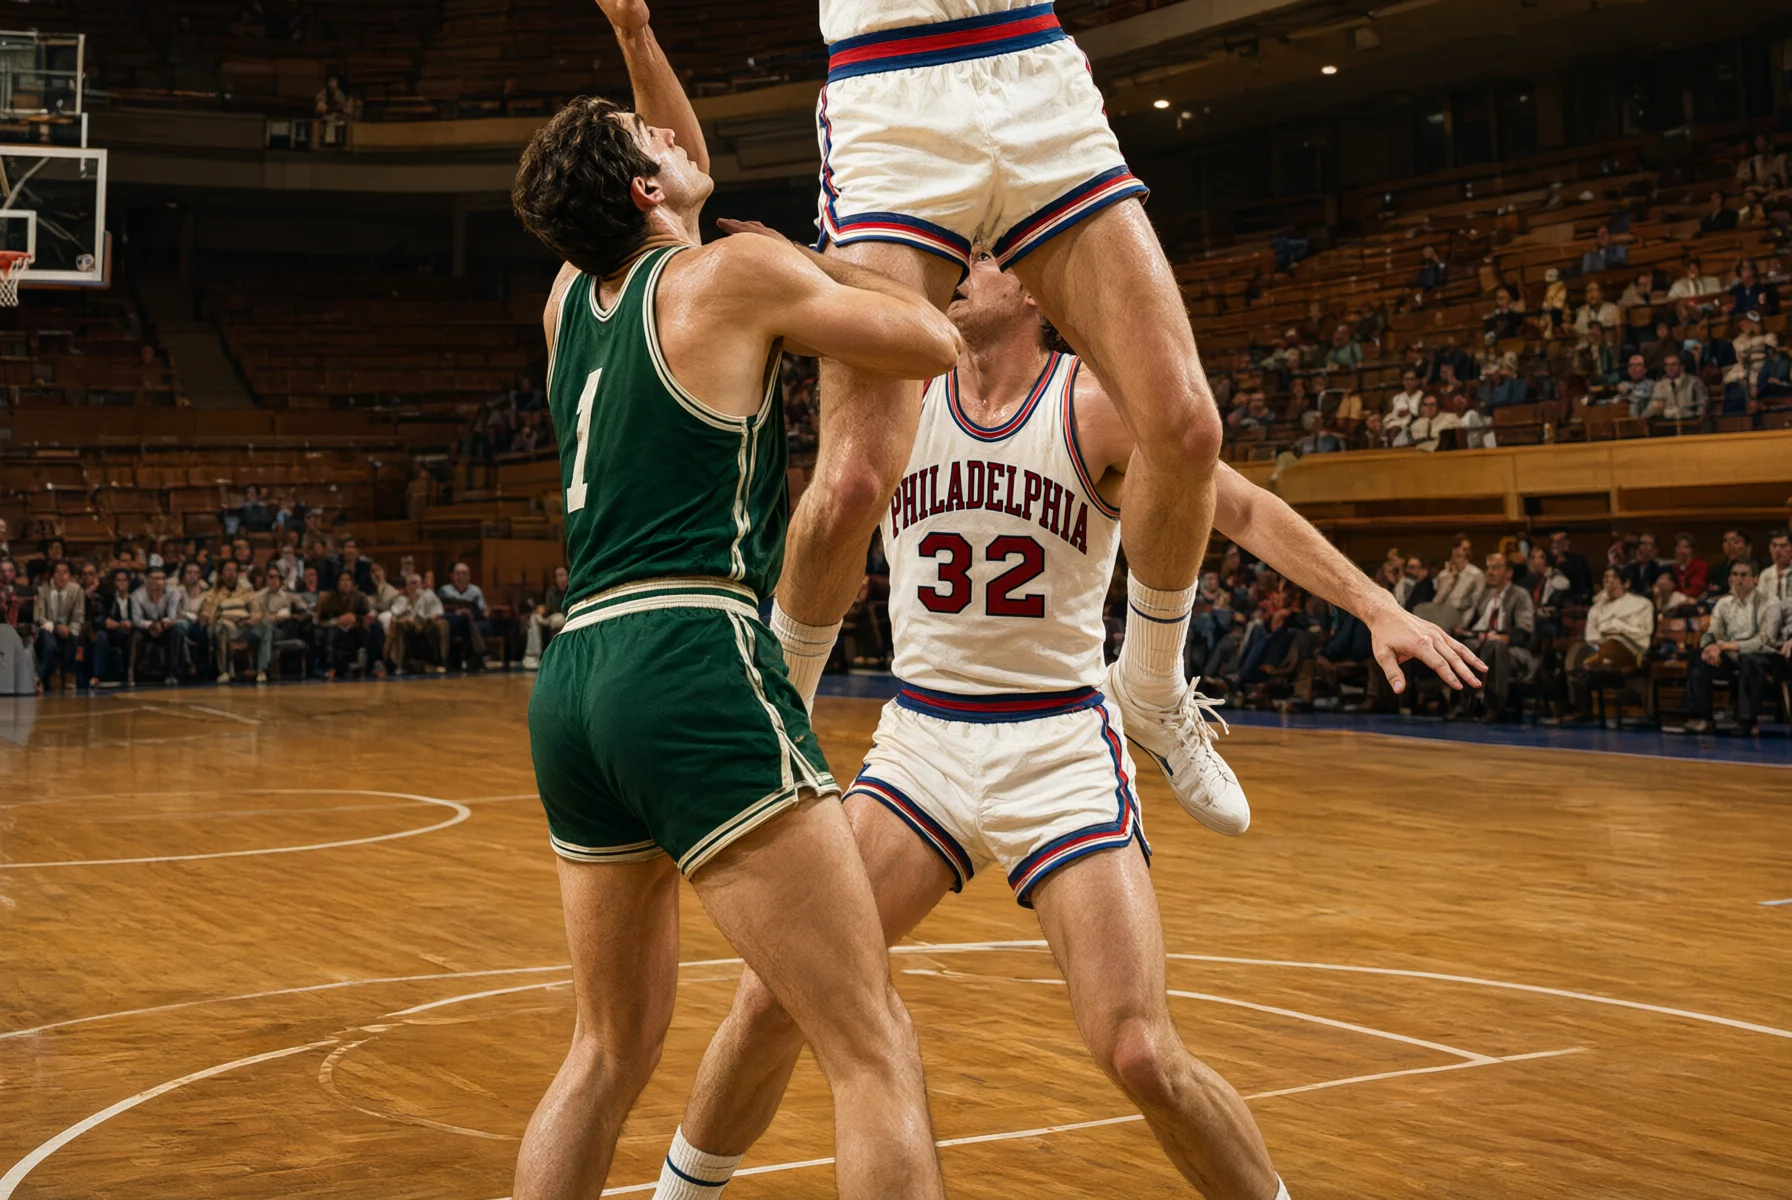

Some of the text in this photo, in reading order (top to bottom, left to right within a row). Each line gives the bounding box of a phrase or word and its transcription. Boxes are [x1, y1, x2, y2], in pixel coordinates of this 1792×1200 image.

[566, 367, 603, 515] 1
[891, 460, 1089, 555] PHILADELPHIA
[917, 531, 1046, 619] 32
